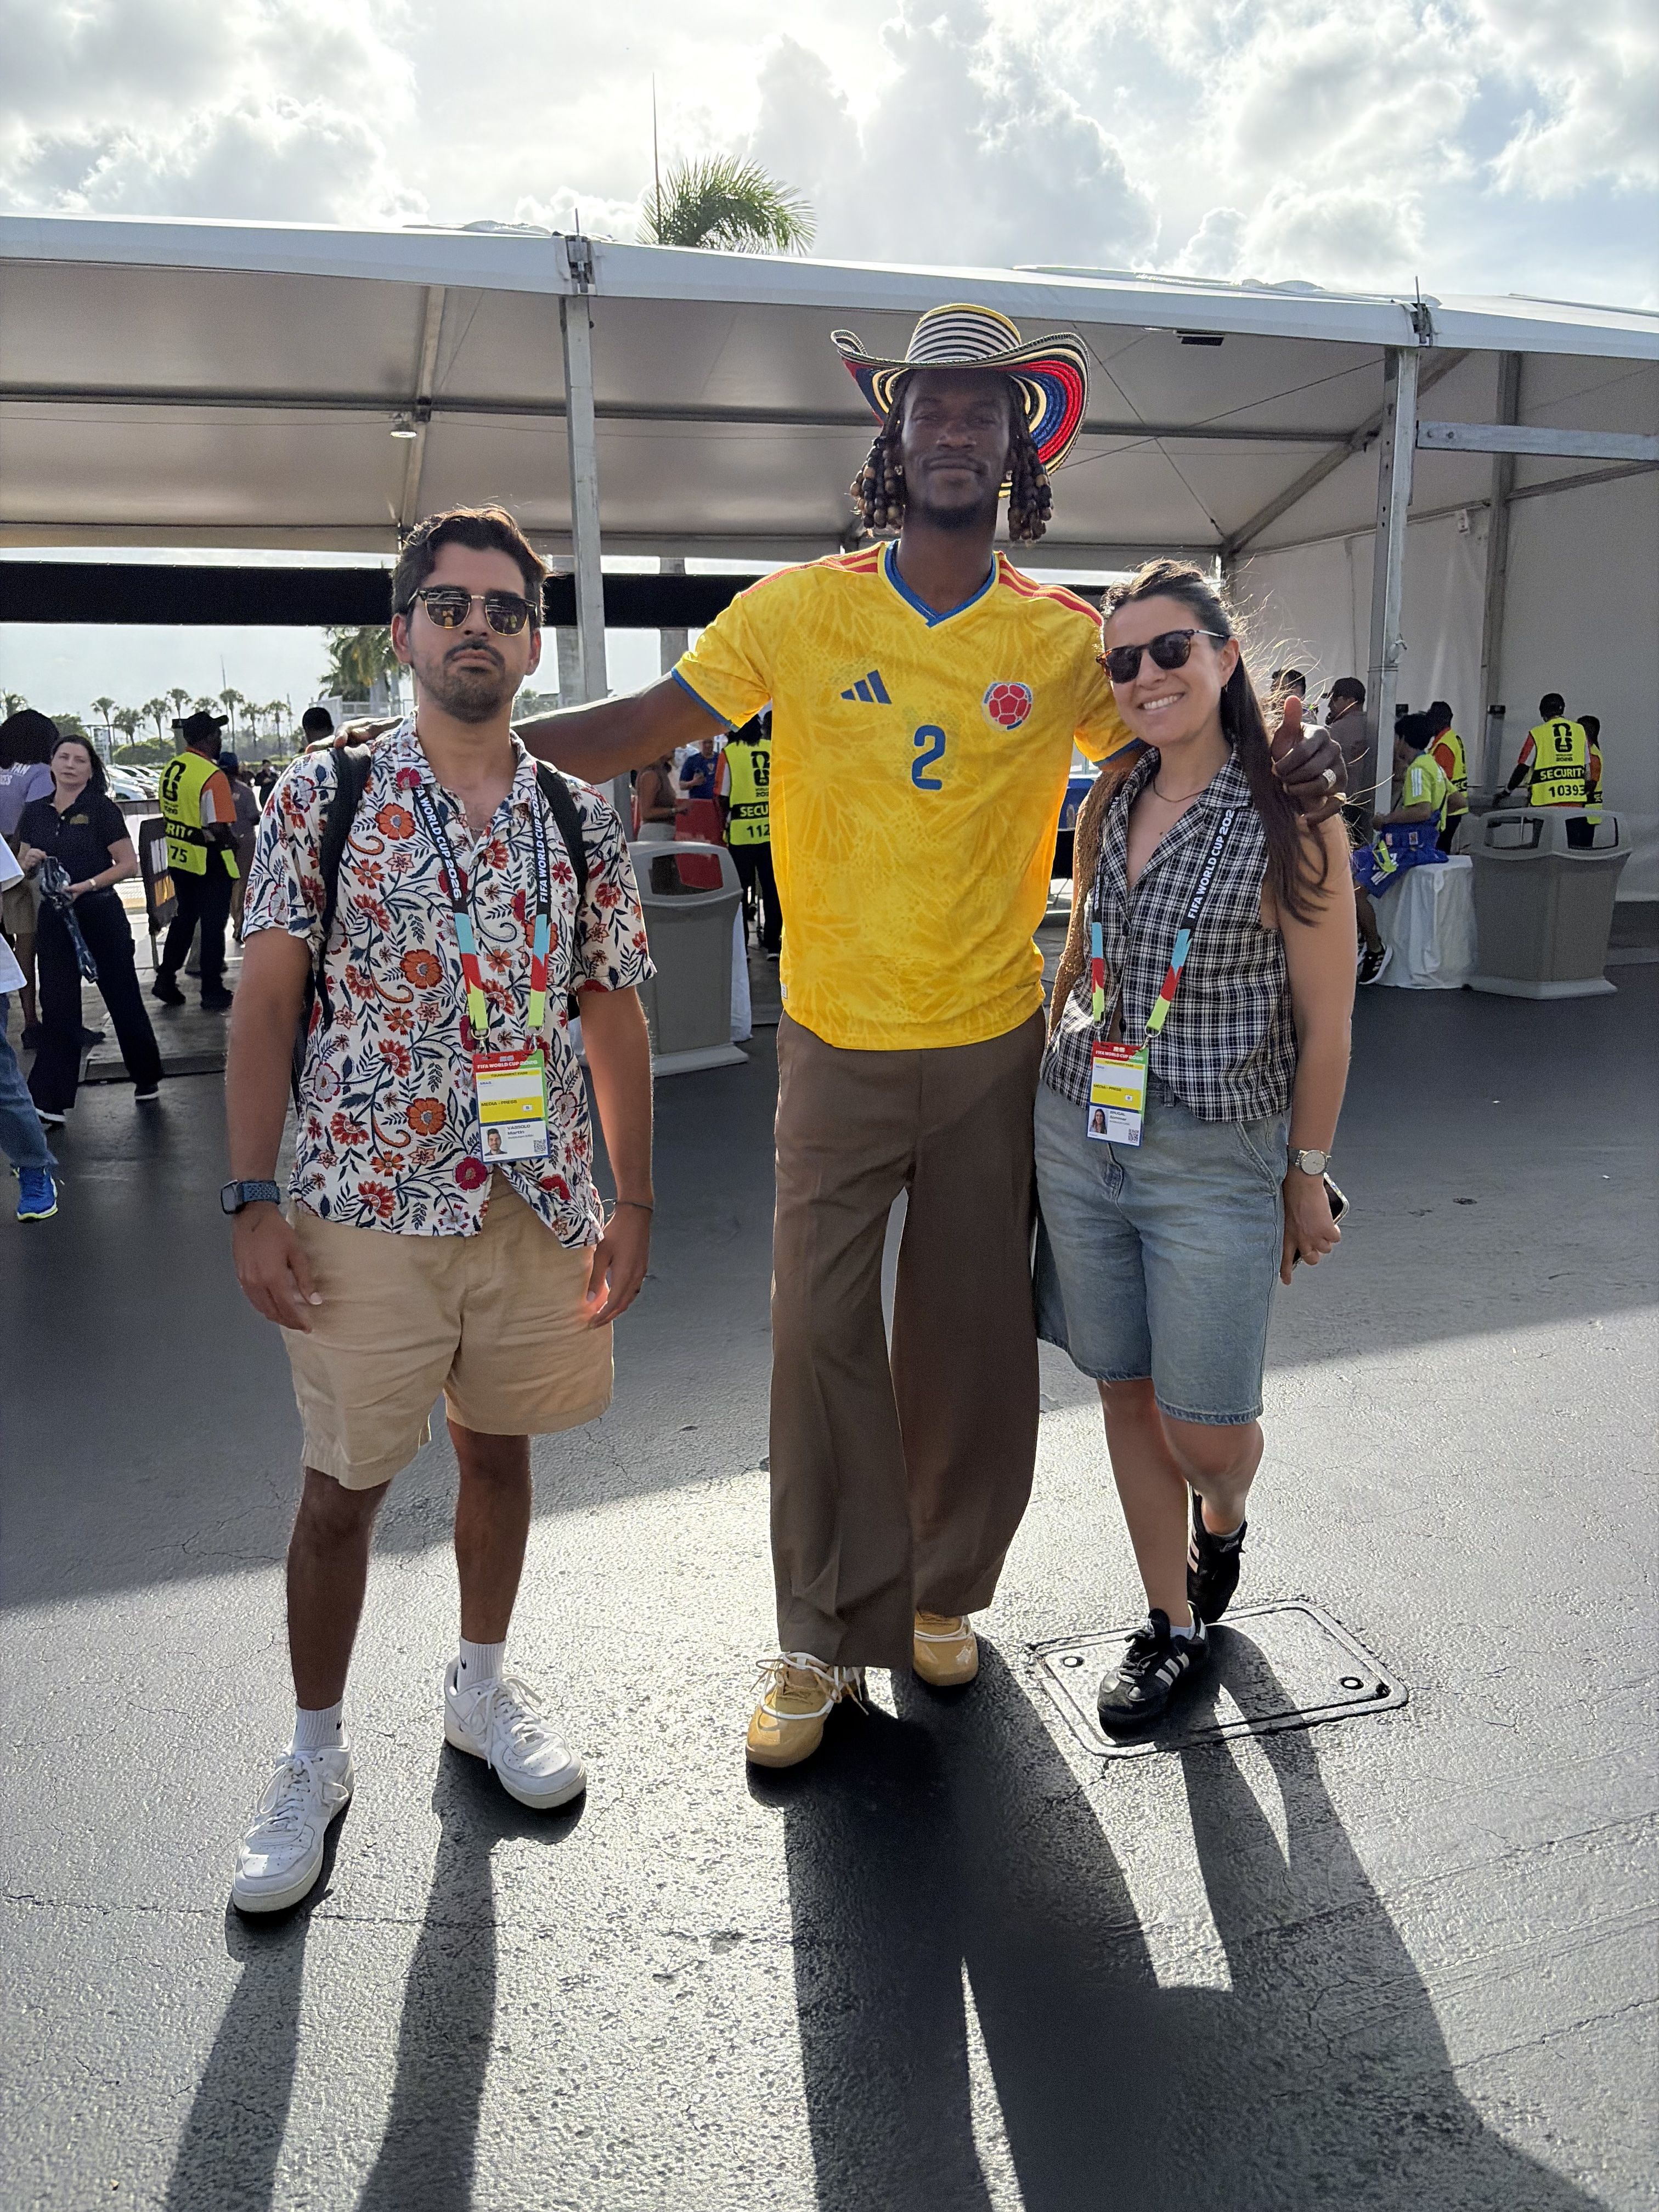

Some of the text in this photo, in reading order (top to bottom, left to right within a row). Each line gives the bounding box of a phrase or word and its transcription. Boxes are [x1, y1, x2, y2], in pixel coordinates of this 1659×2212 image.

[911, 724, 946, 791] 2
[1540, 768, 1584, 780] SECURIT
[1549, 785, 1585, 797] 10393
[740, 805, 769, 817] SECU
[534, 819, 544, 839] CUP
[747, 825, 770, 838] 112
[170, 845, 188, 862] 75
[420, 797, 442, 835] WORLD
[436, 836, 451, 857] CUP
[444, 859, 462, 899] 2026
[536, 842, 547, 878] WORLD
[1187, 809, 1235, 919] FIFA WORLD CUP 202
[540, 879, 548, 903] FIFA
